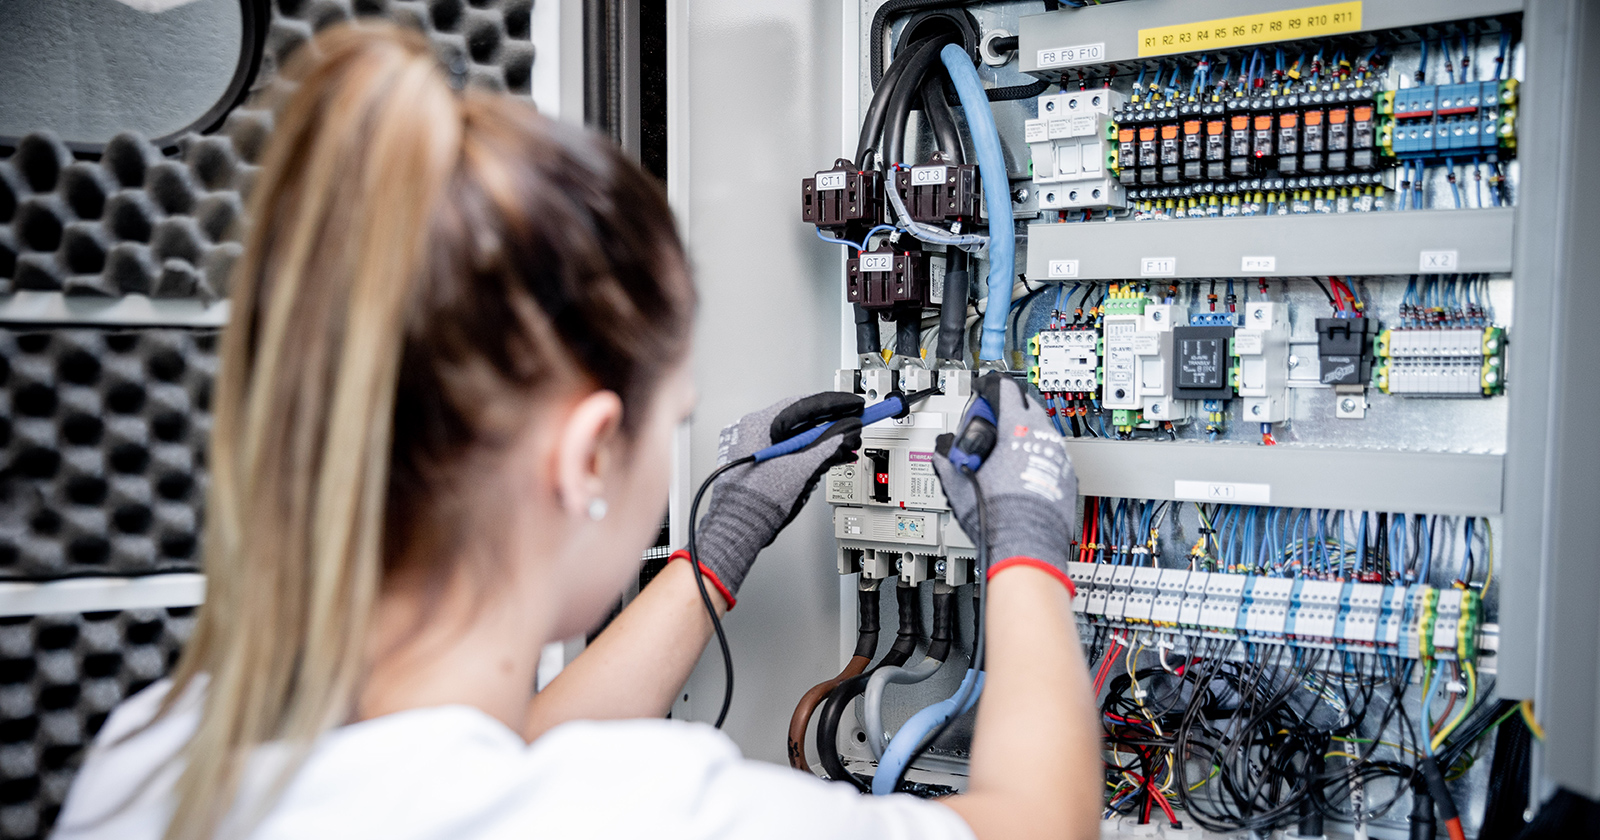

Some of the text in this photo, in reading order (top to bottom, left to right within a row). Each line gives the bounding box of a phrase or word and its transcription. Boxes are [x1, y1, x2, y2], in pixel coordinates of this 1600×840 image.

[1144, 12, 1352, 48] R1 R2 R3 R4 R5 R6 R7 R8 R9 R10 R11
[1043, 47, 1098, 63] F8 F9 F10
[821, 176, 835, 186] CT
[918, 170, 940, 181] CT 3
[866, 257, 887, 268] CT 2
[1428, 254, 1449, 266] X 2
[1055, 263, 1063, 273] K
[1146, 261, 1168, 271] F 11
[1213, 486, 1221, 496] X
